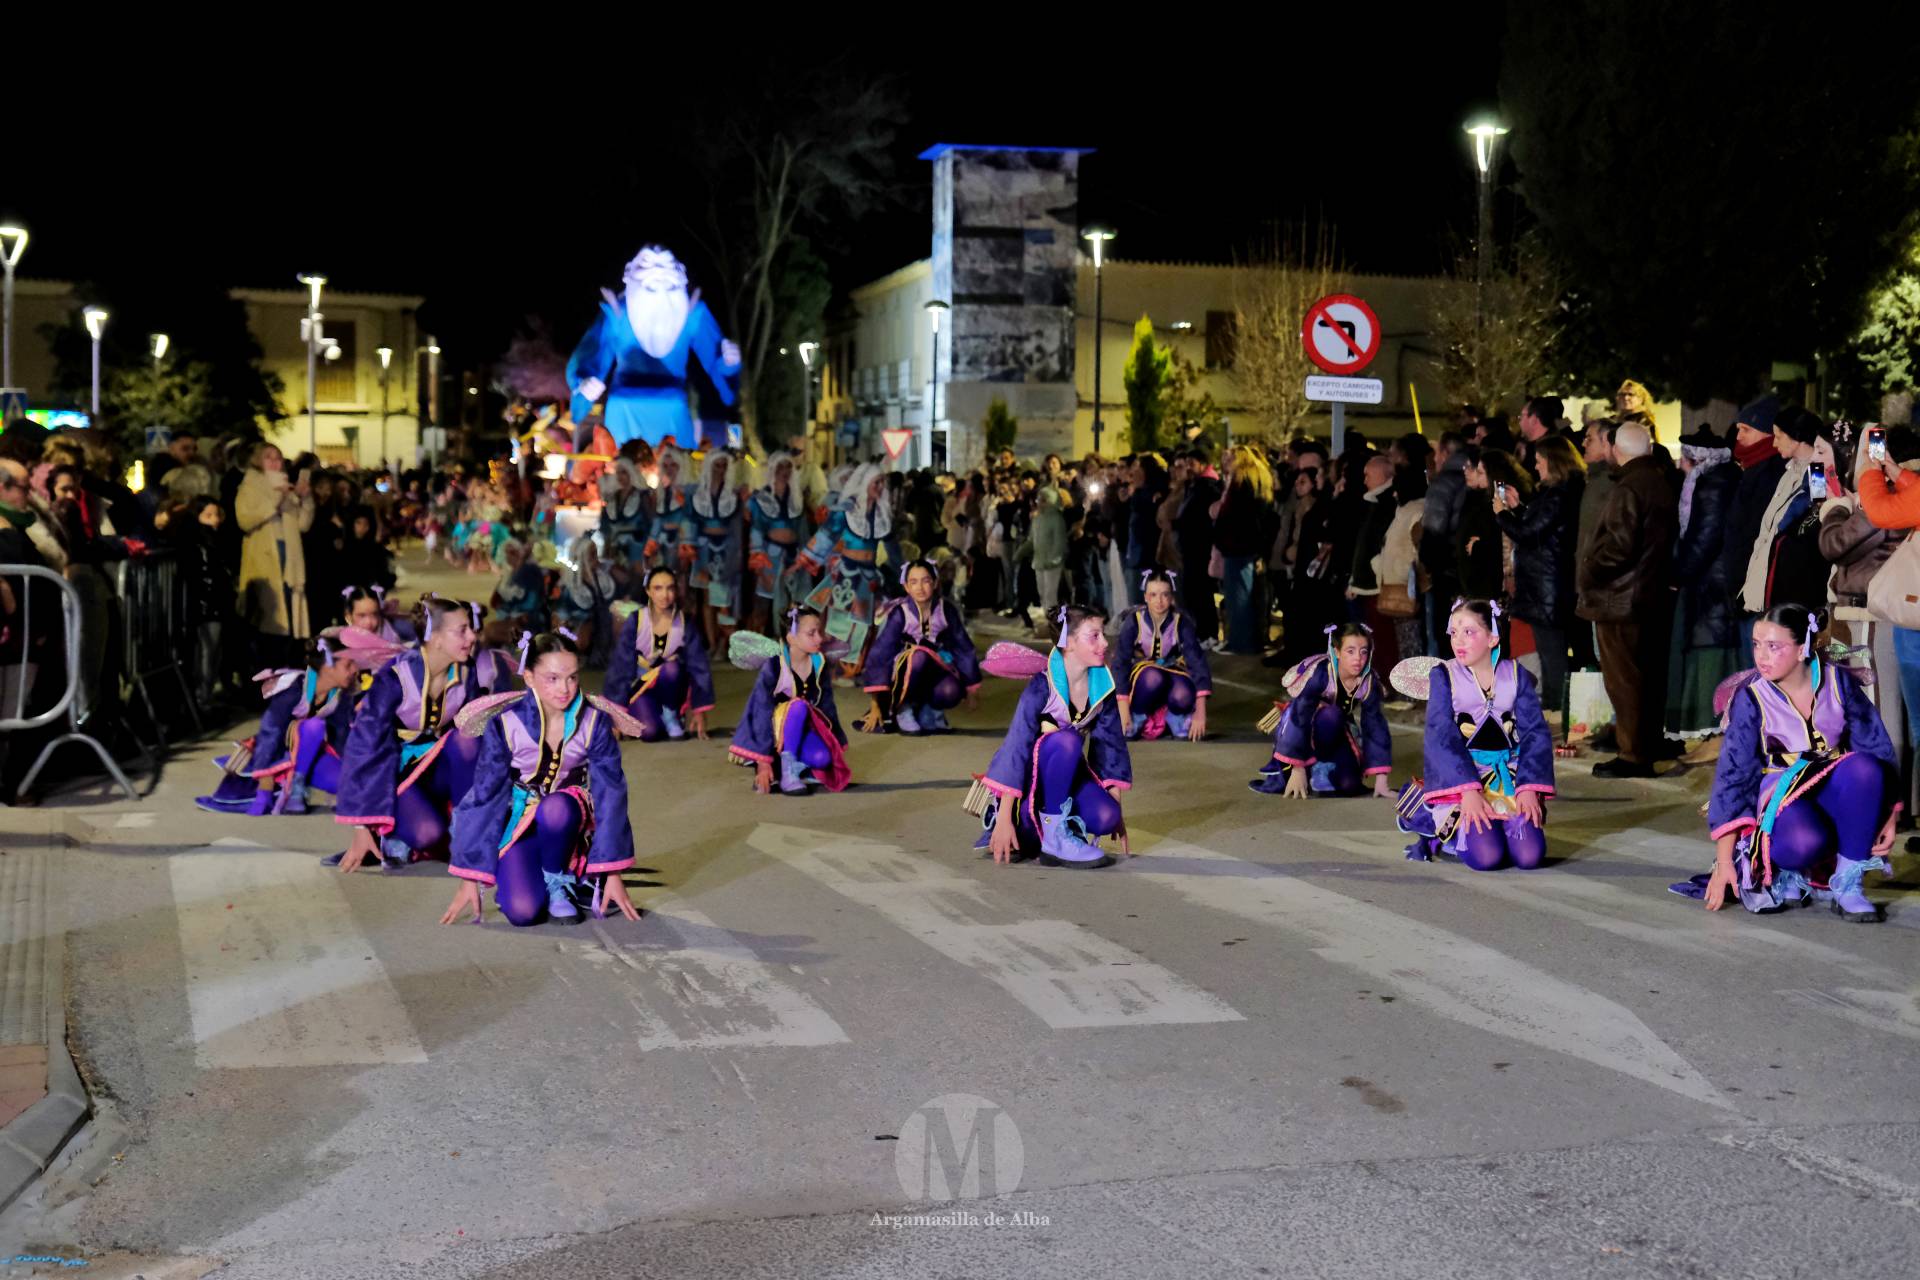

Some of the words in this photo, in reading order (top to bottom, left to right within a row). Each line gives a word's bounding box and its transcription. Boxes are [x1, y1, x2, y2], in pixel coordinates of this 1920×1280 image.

[1308, 380, 1341, 388] EXCEPTO
[1342, 382, 1380, 391] CAMIONES
[1326, 390, 1369, 398] AUTOBUSES
